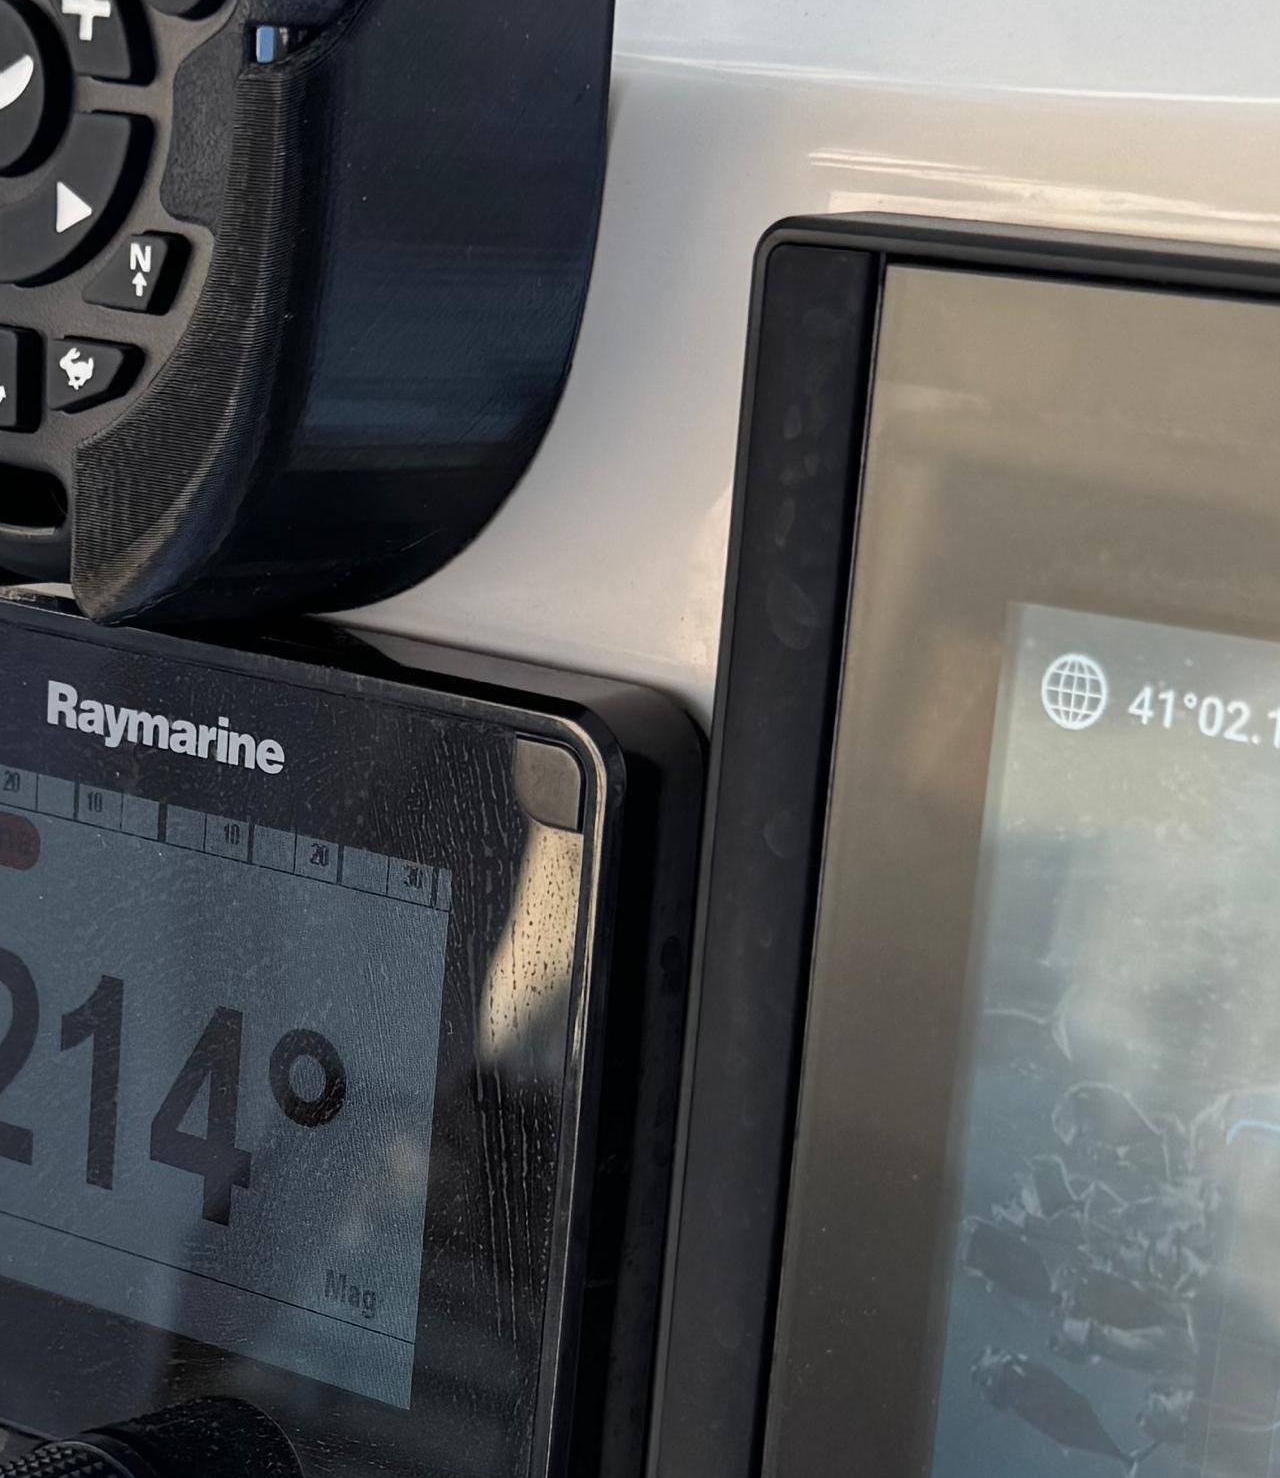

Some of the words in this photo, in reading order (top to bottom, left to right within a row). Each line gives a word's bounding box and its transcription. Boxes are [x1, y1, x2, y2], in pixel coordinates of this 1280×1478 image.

[129, 242, 152, 273] N
[47, 680, 286, 774] Raymarine
[324, 1269, 378, 1320] Mag
